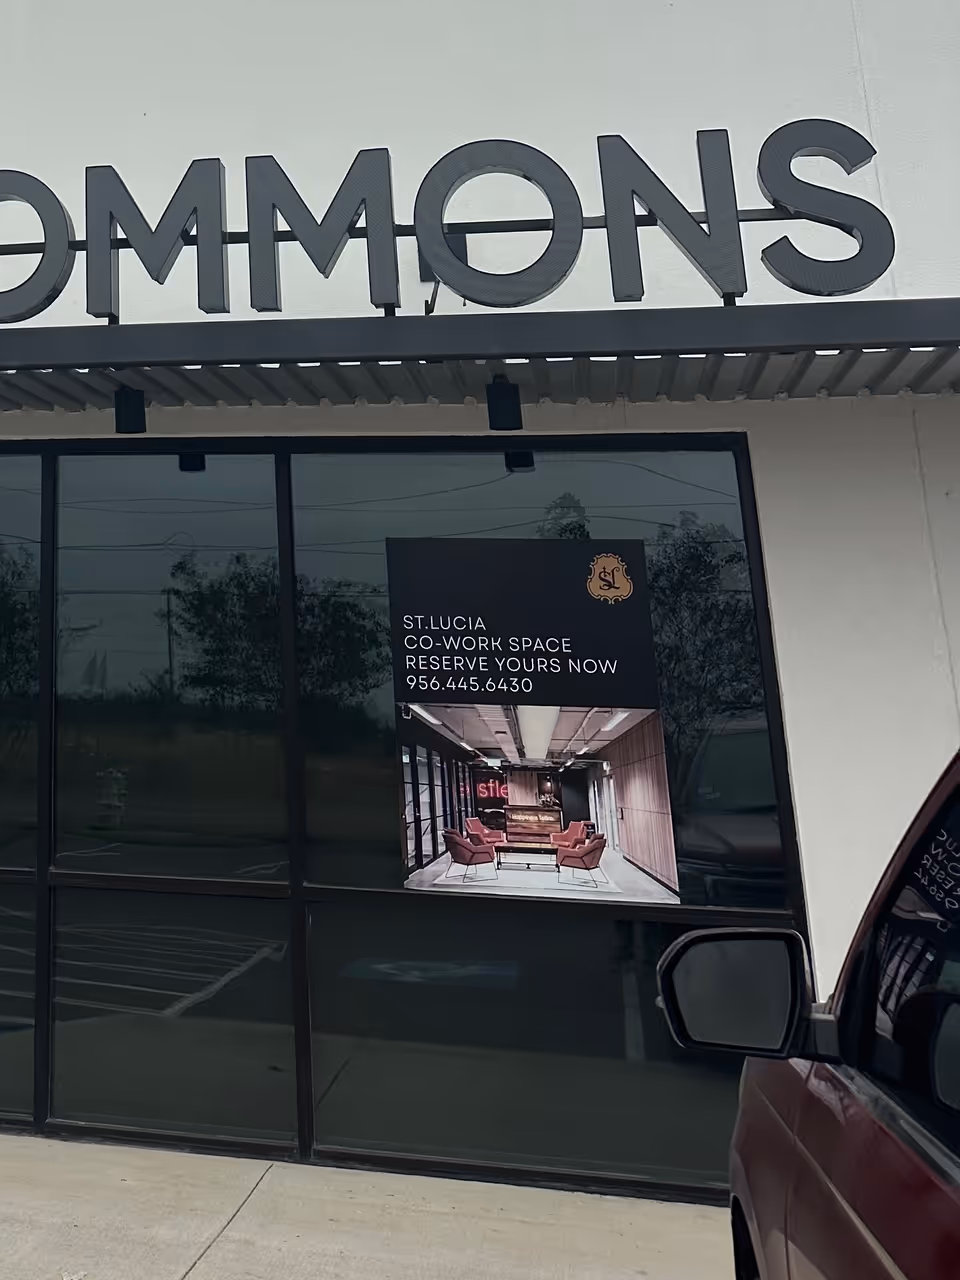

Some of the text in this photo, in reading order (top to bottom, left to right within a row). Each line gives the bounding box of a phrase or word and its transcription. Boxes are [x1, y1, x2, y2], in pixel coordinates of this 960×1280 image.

[402, 614, 487, 631] ST.LUCIA
[404, 634, 572, 653] CO-WORK SPACE
[405, 655, 618, 674] RESERVE YOURS NOW
[406, 675, 533, 693] 956.445.6430
